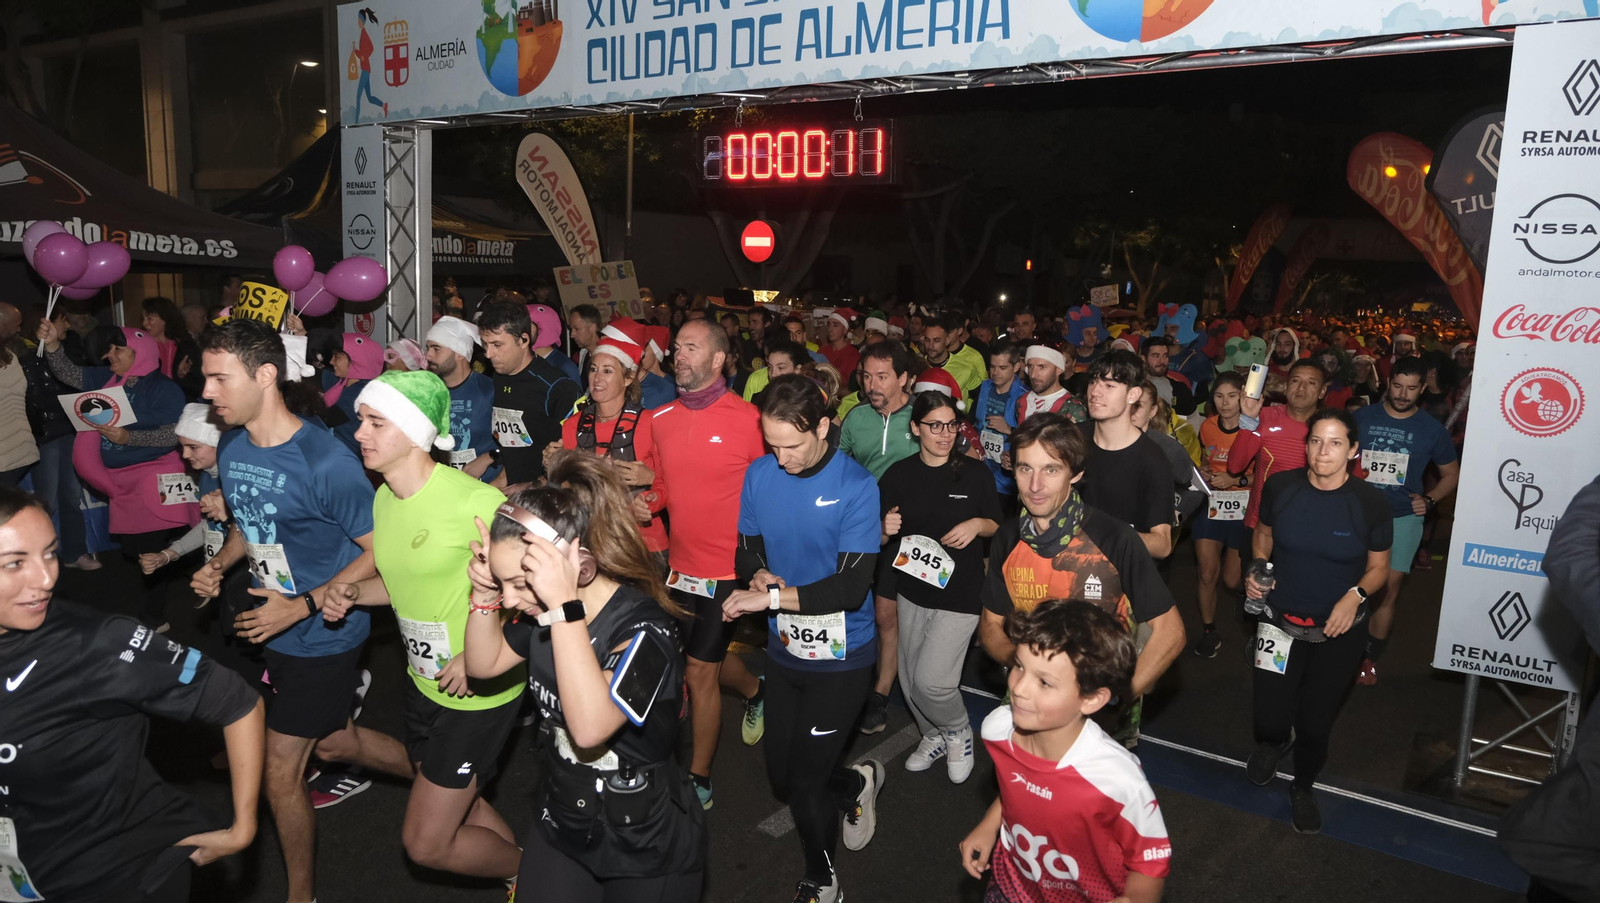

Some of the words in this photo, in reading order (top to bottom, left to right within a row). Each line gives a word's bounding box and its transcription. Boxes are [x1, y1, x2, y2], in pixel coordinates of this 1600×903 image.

[416, 40, 467, 62] ALMERÍA
[587, 22, 717, 84] CIUDAD
[730, 13, 782, 69] DE
[428, 59, 454, 72] CIUDAD
[1521, 147, 1554, 156] SYRSA
[1557, 146, 1600, 156] AUTOM
[346, 181, 376, 189] RENAULT
[1513, 223, 1598, 234] NISSA
[558, 268, 582, 286] EL
[590, 262, 634, 282] PODER
[587, 283, 612, 299] ES
[495, 421, 521, 434] 1013
[984, 441, 1001, 454] 833
[1371, 462, 1396, 473] 875
[166, 482, 193, 494] 714
[1217, 500, 1240, 510] 709
[911, 547, 942, 569] 945
[1084, 584, 1102, 592] CXM
[790, 624, 829, 644] 364
[1452, 644, 1557, 672] RENAULT
[1450, 658, 1481, 672] SYRSA
[1484, 664, 1553, 685] AUTOMOCION
[1026, 782, 1052, 800] rasán
[1042, 879, 1063, 890] sport
